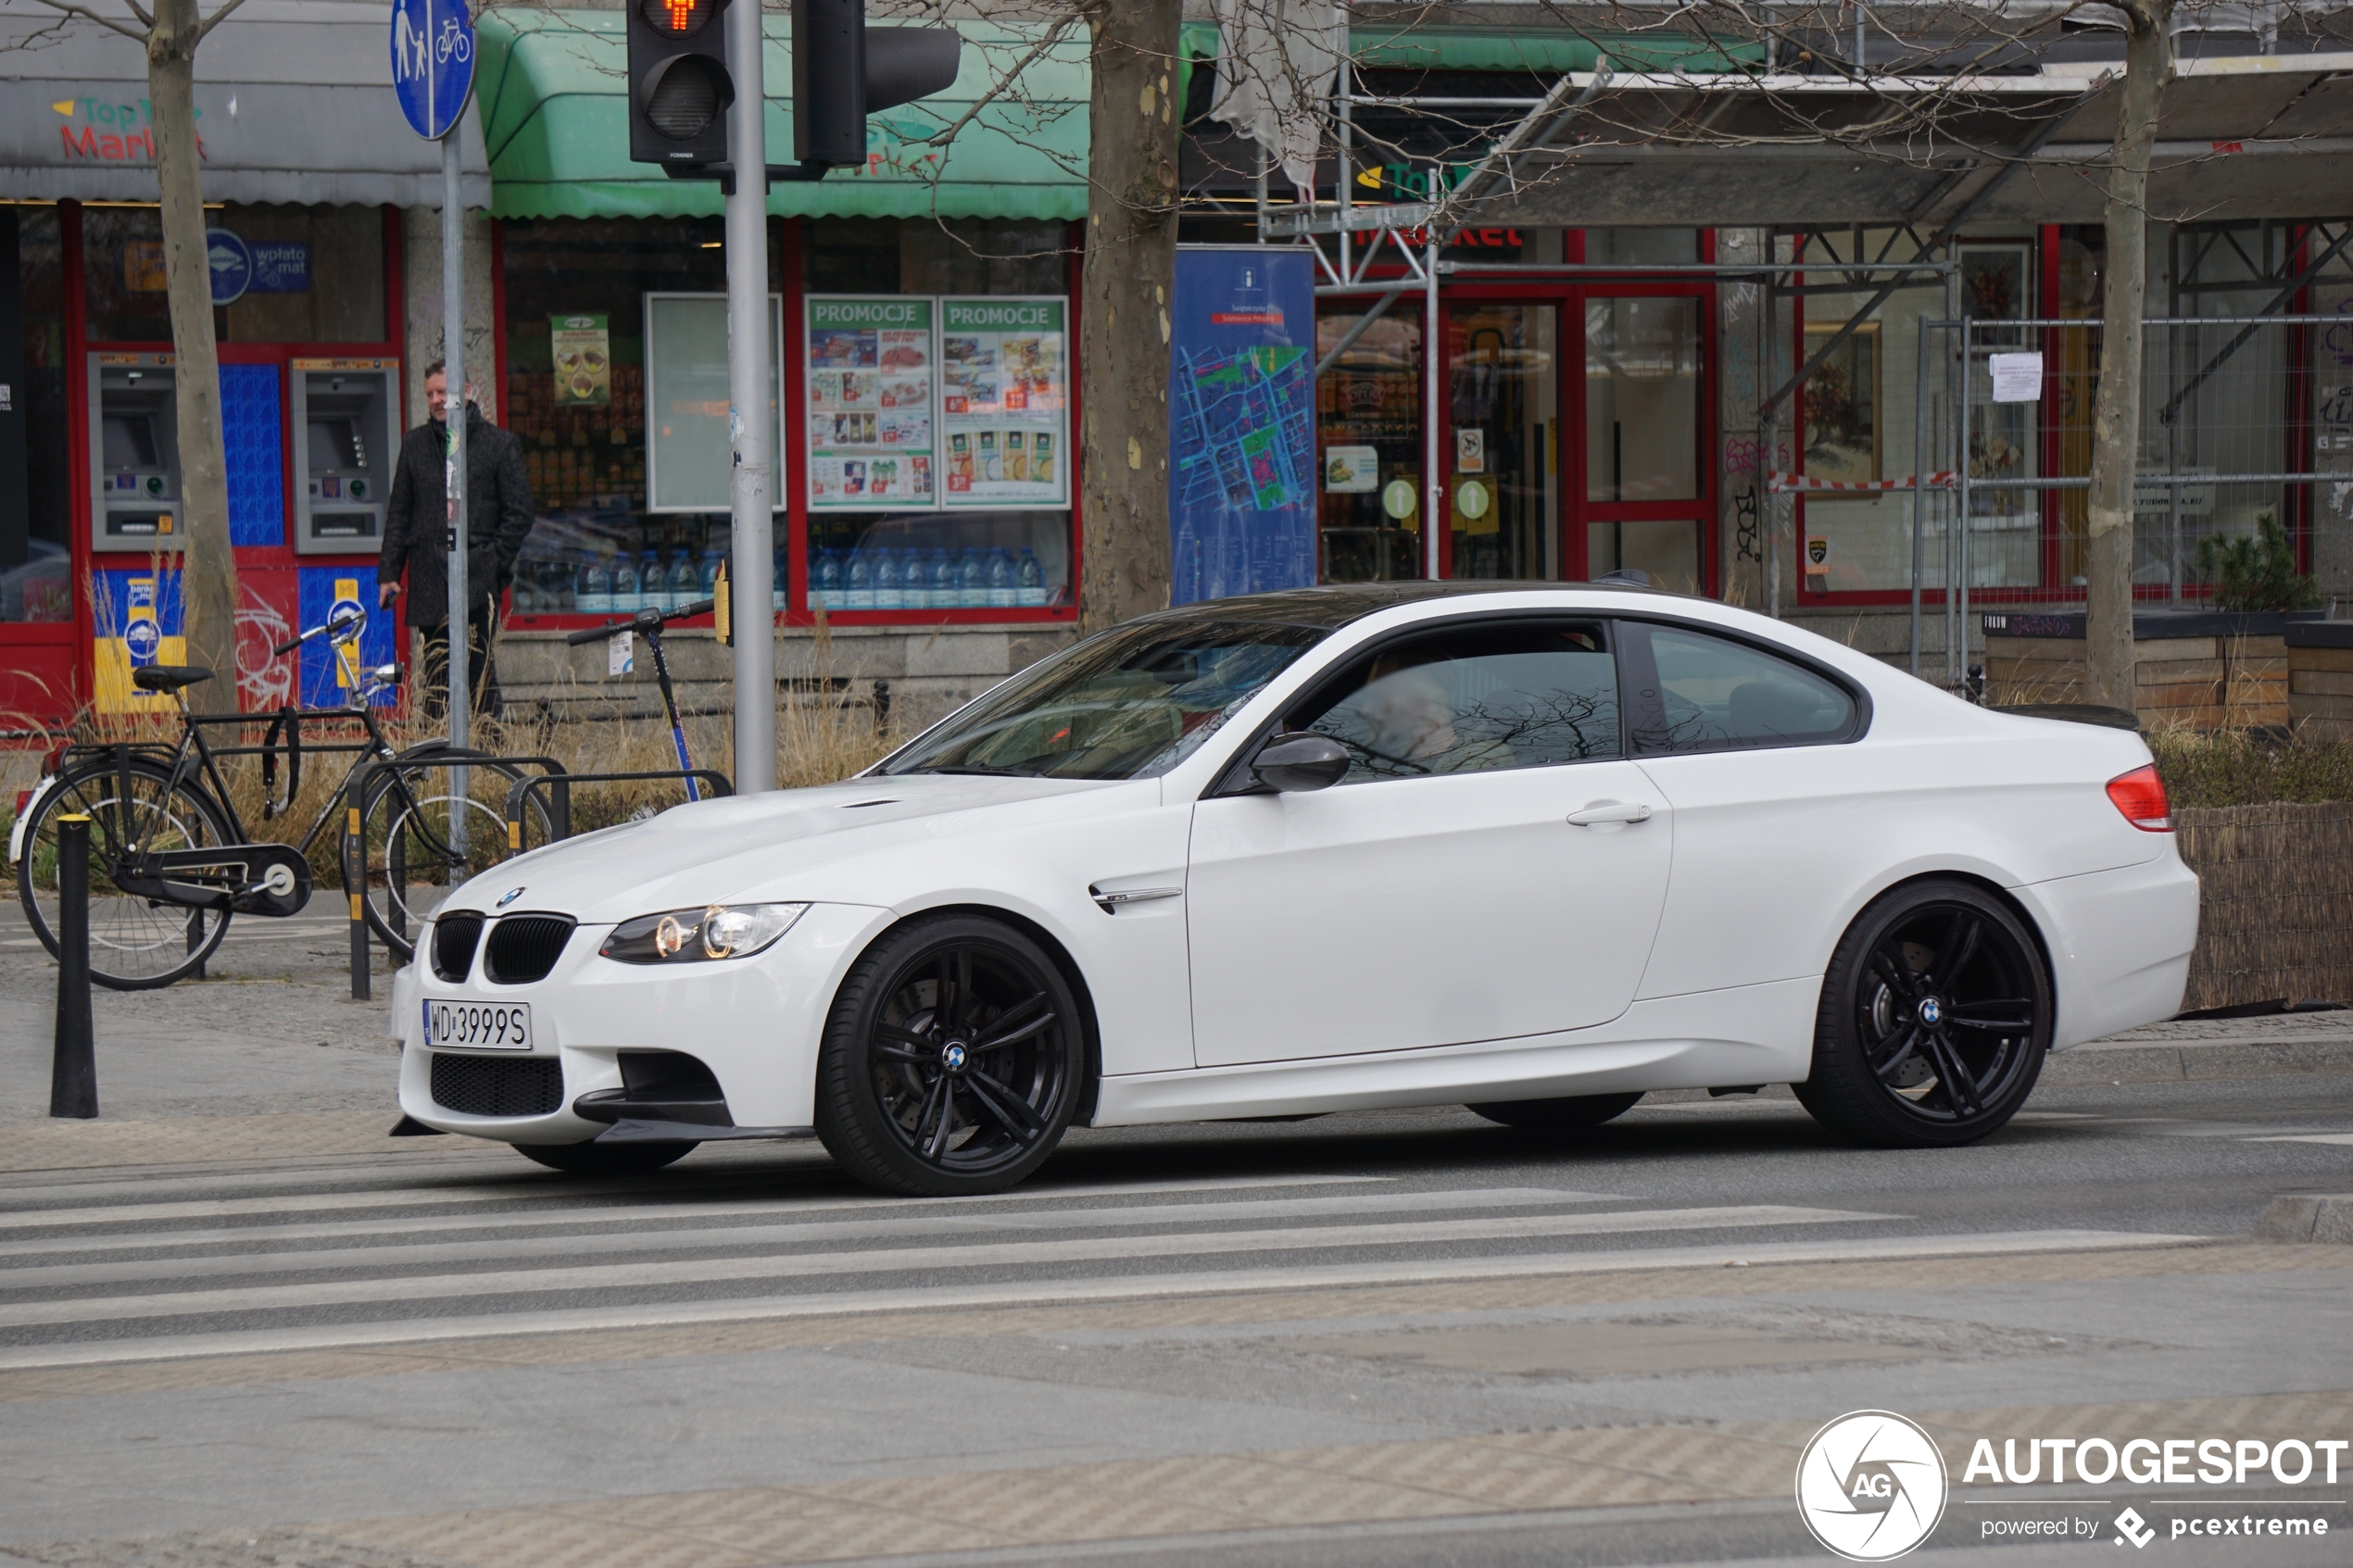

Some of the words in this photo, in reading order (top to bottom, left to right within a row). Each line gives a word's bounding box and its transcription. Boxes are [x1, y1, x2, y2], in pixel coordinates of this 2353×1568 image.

[79, 97, 137, 132] Top
[257, 247, 306, 264] wpłato
[279, 262, 306, 274] mat
[816, 305, 916, 322] PROMOCJE
[950, 307, 1049, 325] PROMOCJE
[431, 1005, 451, 1042] WD
[458, 1006, 525, 1045] 3999S
